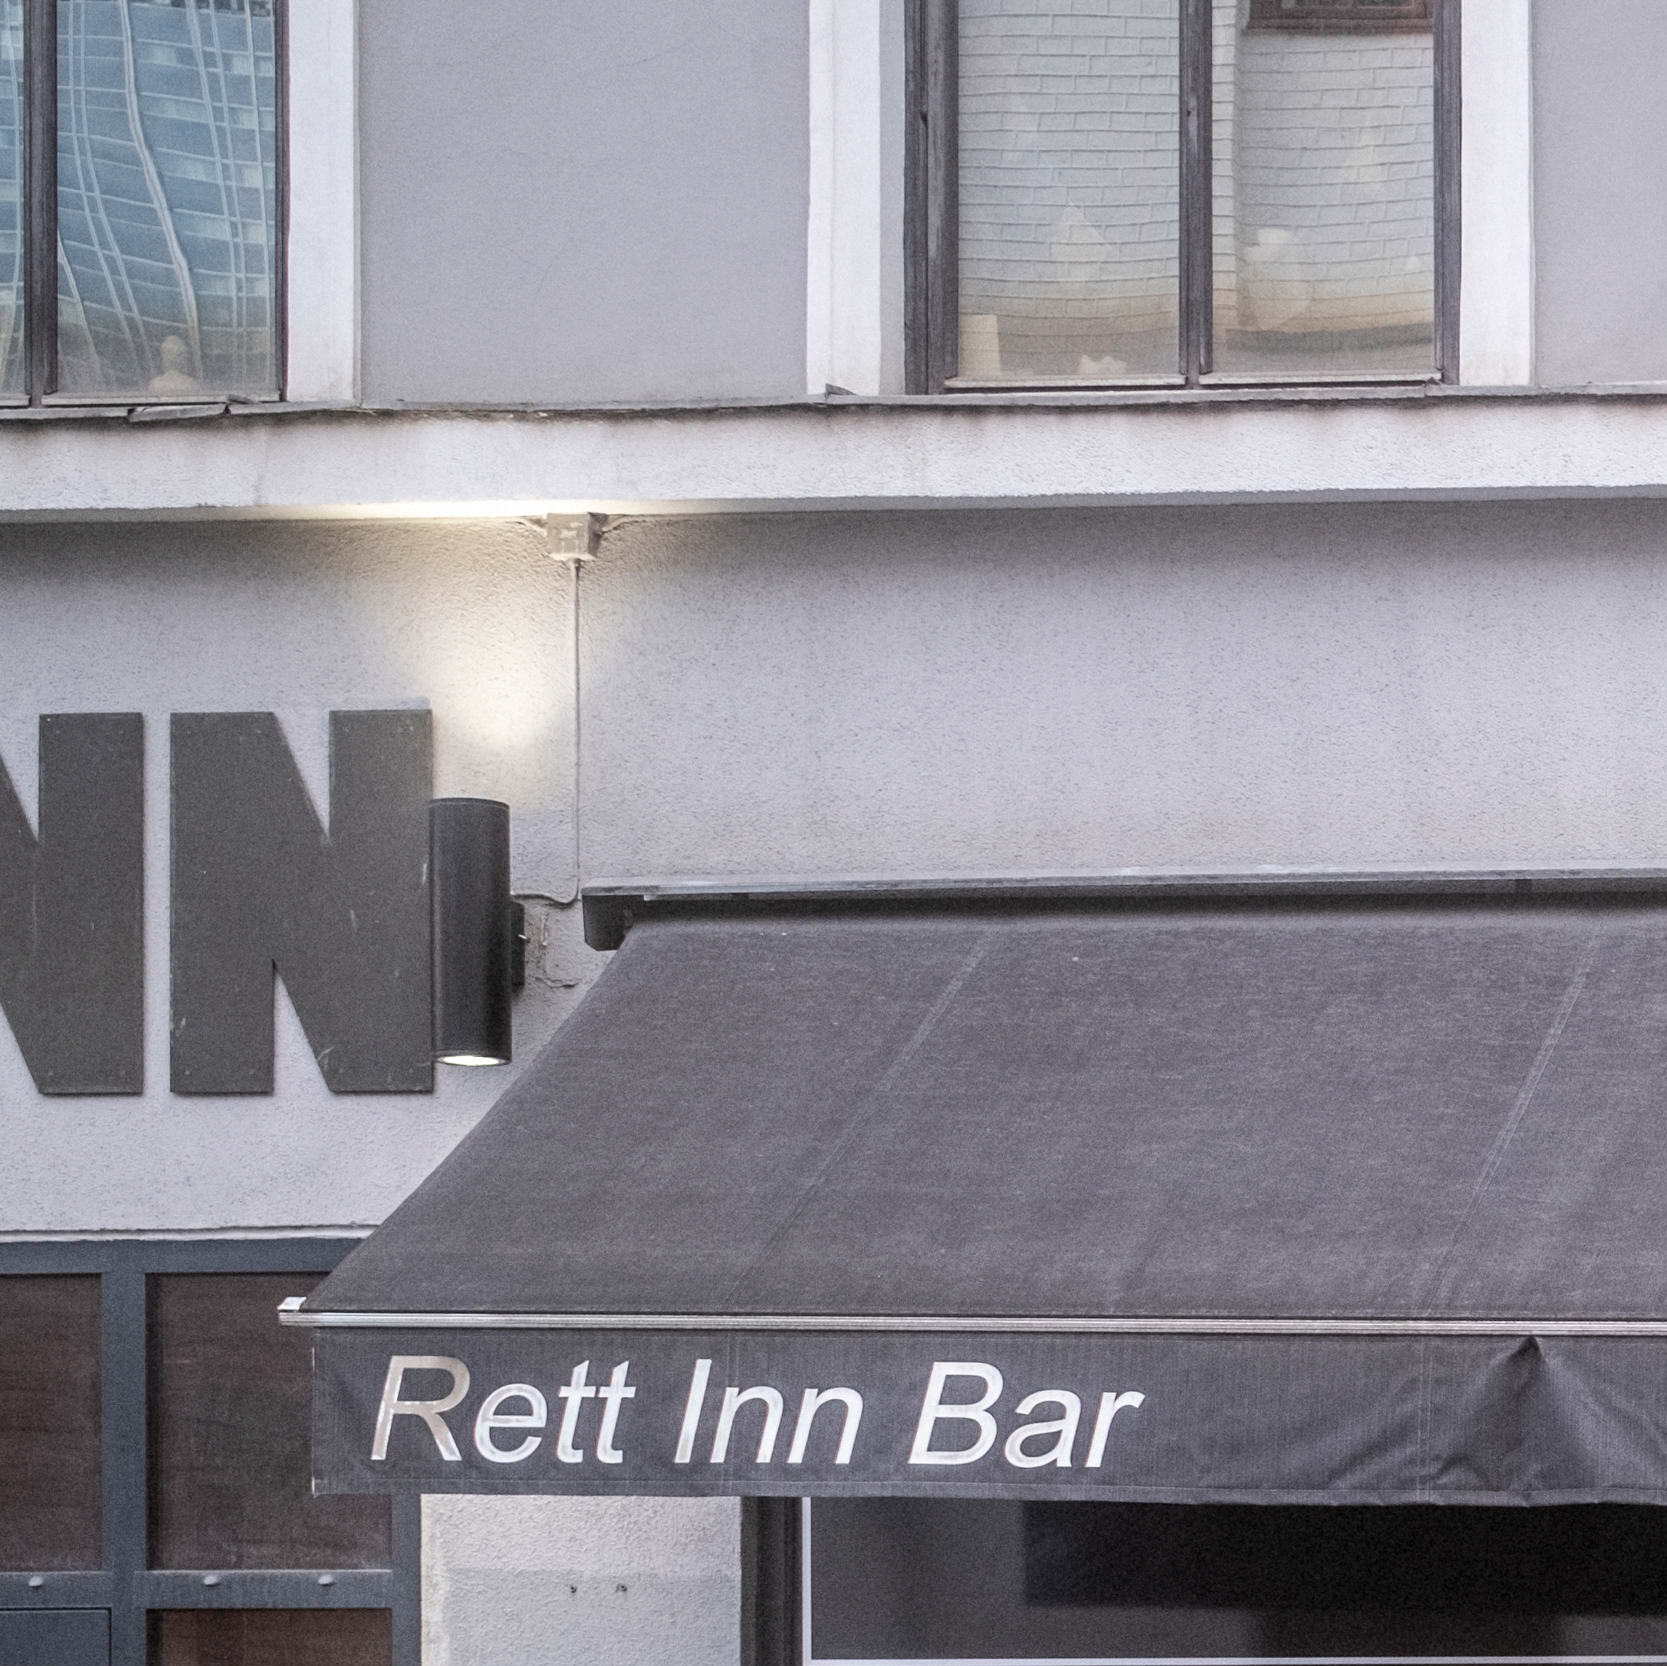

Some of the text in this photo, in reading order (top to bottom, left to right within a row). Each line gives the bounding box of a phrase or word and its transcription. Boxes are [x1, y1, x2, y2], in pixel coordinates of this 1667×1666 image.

[371, 1356, 1145, 1468] Rett Inn Bar
